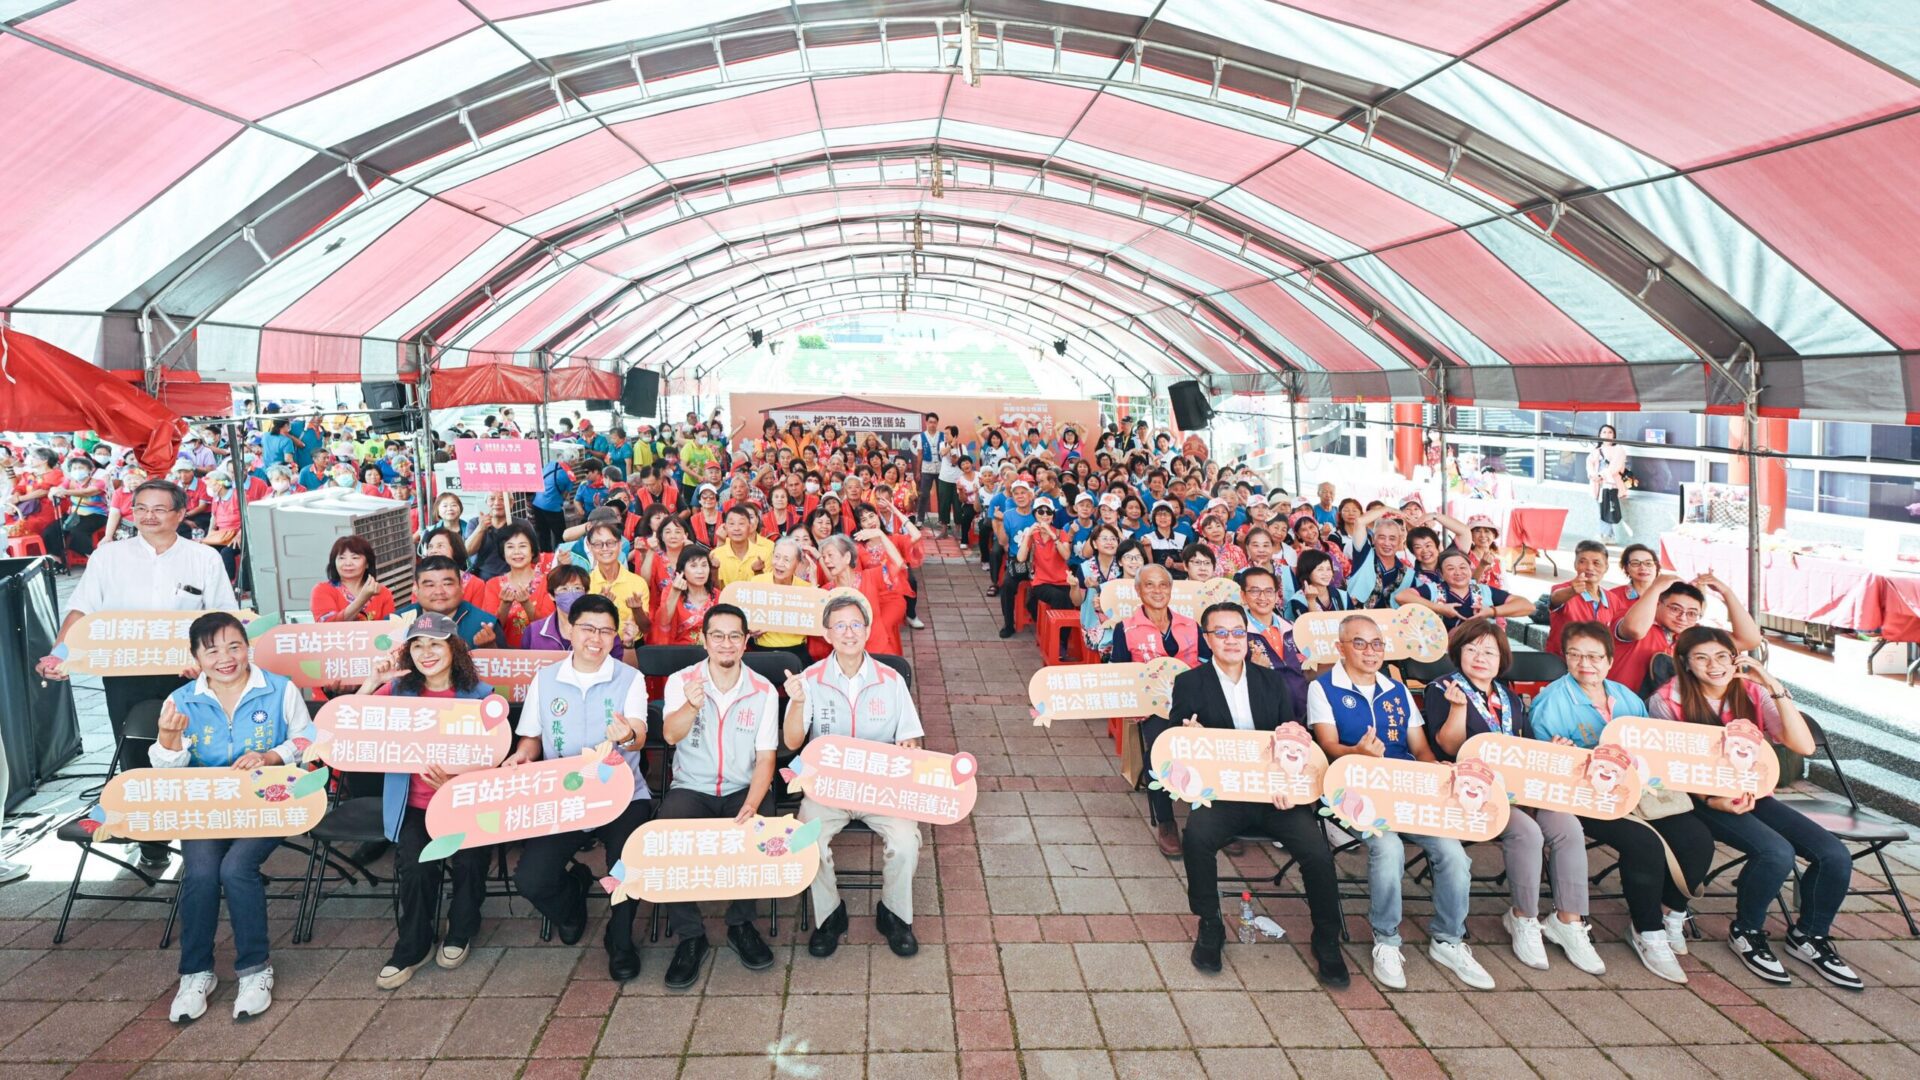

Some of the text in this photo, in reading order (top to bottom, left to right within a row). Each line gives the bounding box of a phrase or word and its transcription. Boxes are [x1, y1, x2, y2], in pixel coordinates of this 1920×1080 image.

[814, 415, 906, 428] 桃園市伯公照護站
[736, 588, 783, 606] 桃園市
[88, 618, 192, 641] 創新客家
[1308, 619, 1340, 635] 桃園
[274, 630, 370, 654] 百站共行
[88, 647, 255, 669] 青銀共創
[325, 655, 384, 679] 桃園
[1046, 672, 1098, 690] 桃園市
[1050, 692, 1138, 713] 伯公照護站
[335, 704, 437, 732] 全國最多
[331, 738, 494, 767] 桃園伯公照護站
[1169, 735, 1262, 763] 伯公照護
[1619, 724, 1712, 758] 伯公照護
[819, 743, 913, 779] 全國最多
[1478, 740, 1576, 777] 伯公照護
[122, 777, 242, 803] 創新客家
[451, 769, 559, 809] 百站共行
[1219, 769, 1315, 798] 客庄長者
[1344, 763, 1440, 798] 伯公照護
[1667, 760, 1761, 793] 客庄長者
[813, 775, 961, 820] 桃園伯公照護站
[1523, 777, 1619, 815] 客庄長者
[126, 806, 309, 833] 青銀共創新風華
[504, 795, 613, 832] 桃園第一
[1393, 801, 1491, 835] 客庄長者
[642, 828, 746, 857] 創新客家
[642, 862, 805, 893] 青銀共創新風華
